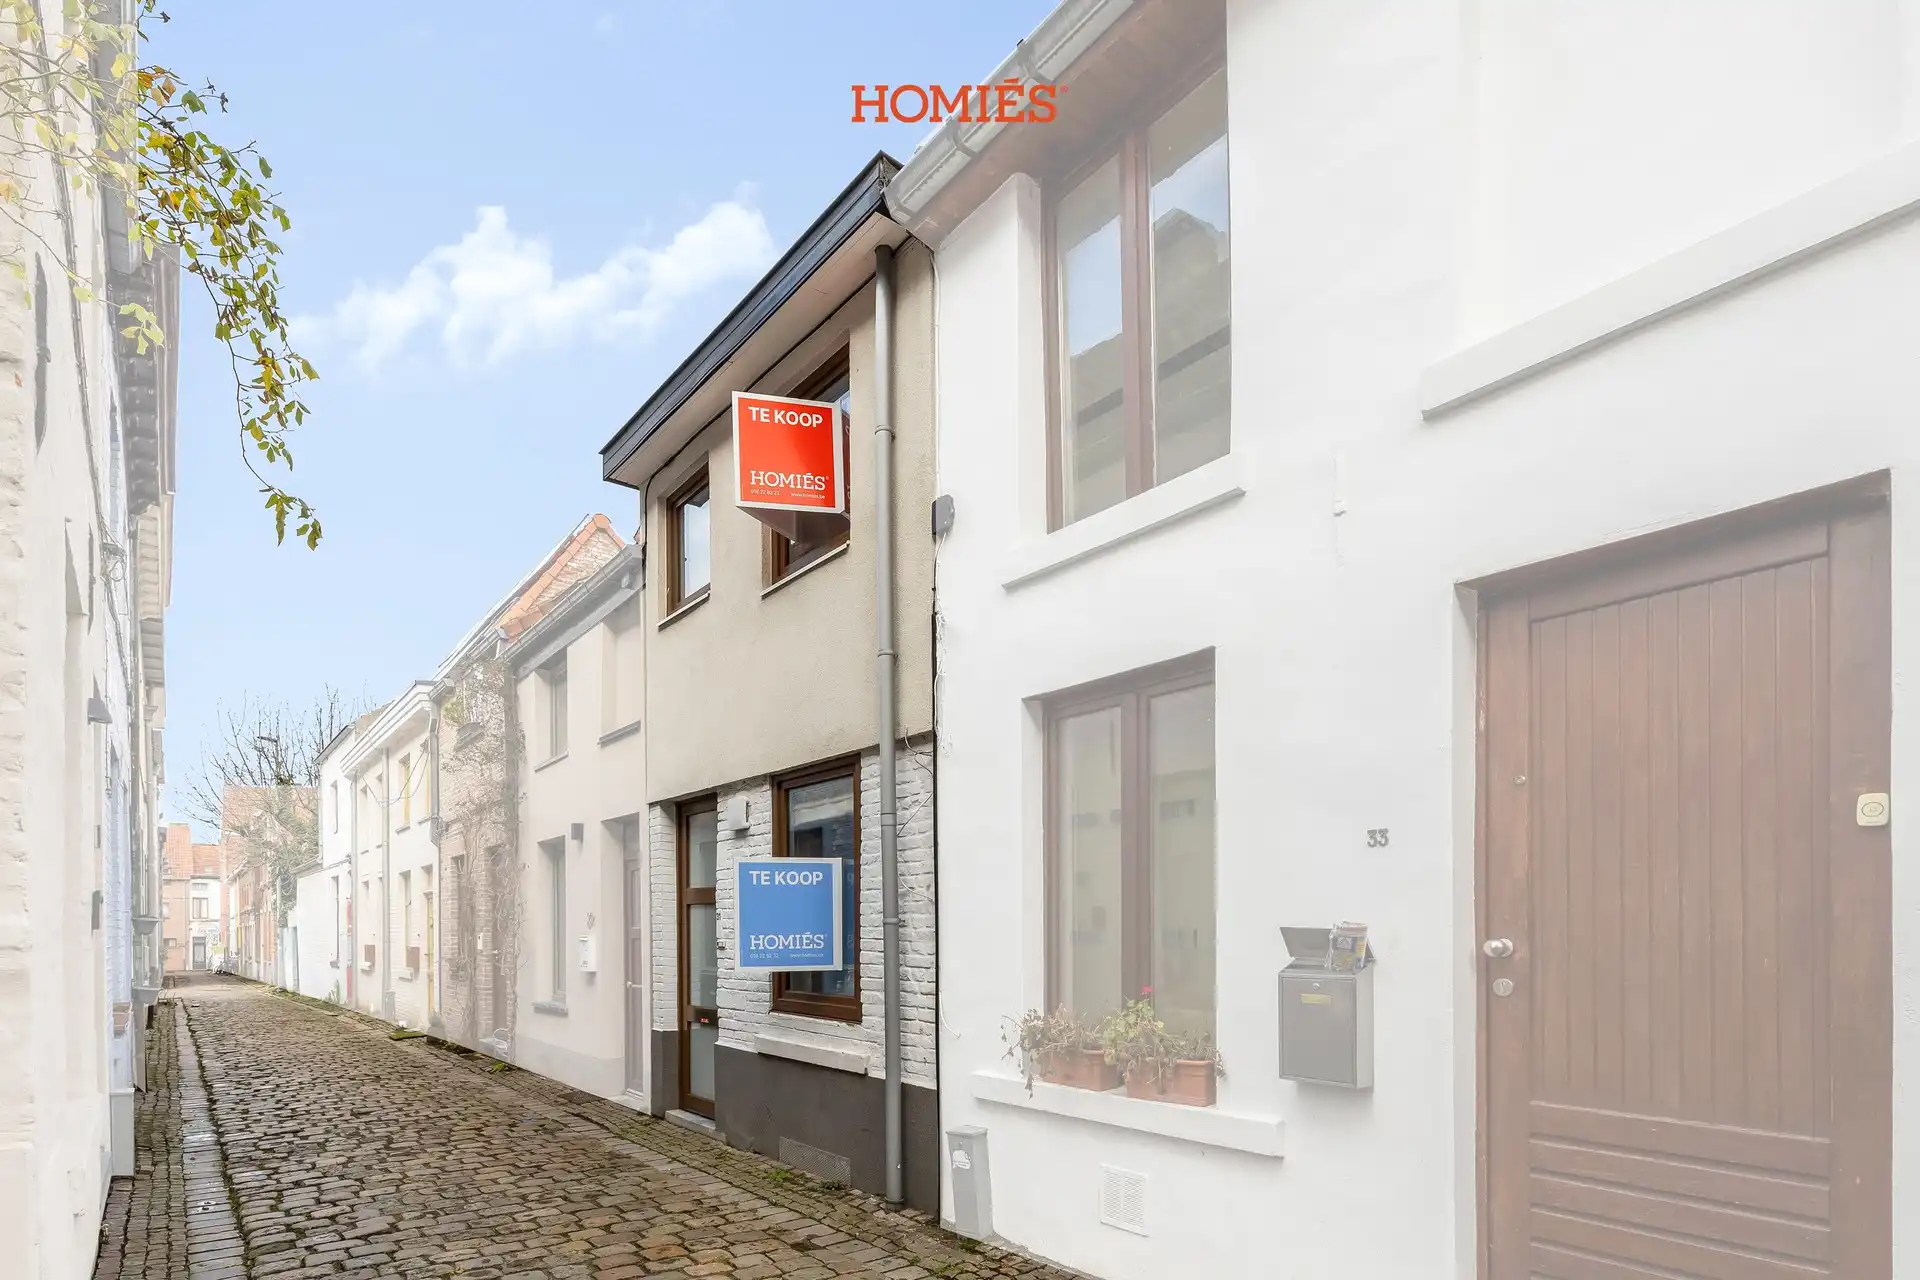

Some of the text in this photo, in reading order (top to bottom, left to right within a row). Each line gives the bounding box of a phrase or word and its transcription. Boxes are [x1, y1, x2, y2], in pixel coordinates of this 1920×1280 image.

[748, 407, 824, 428] TE KOOP
[750, 470, 826, 491] HOMIÉS
[1366, 828, 1390, 848] 33
[749, 870, 824, 885] TE KOOP
[750, 932, 825, 950] HOMIÉS
